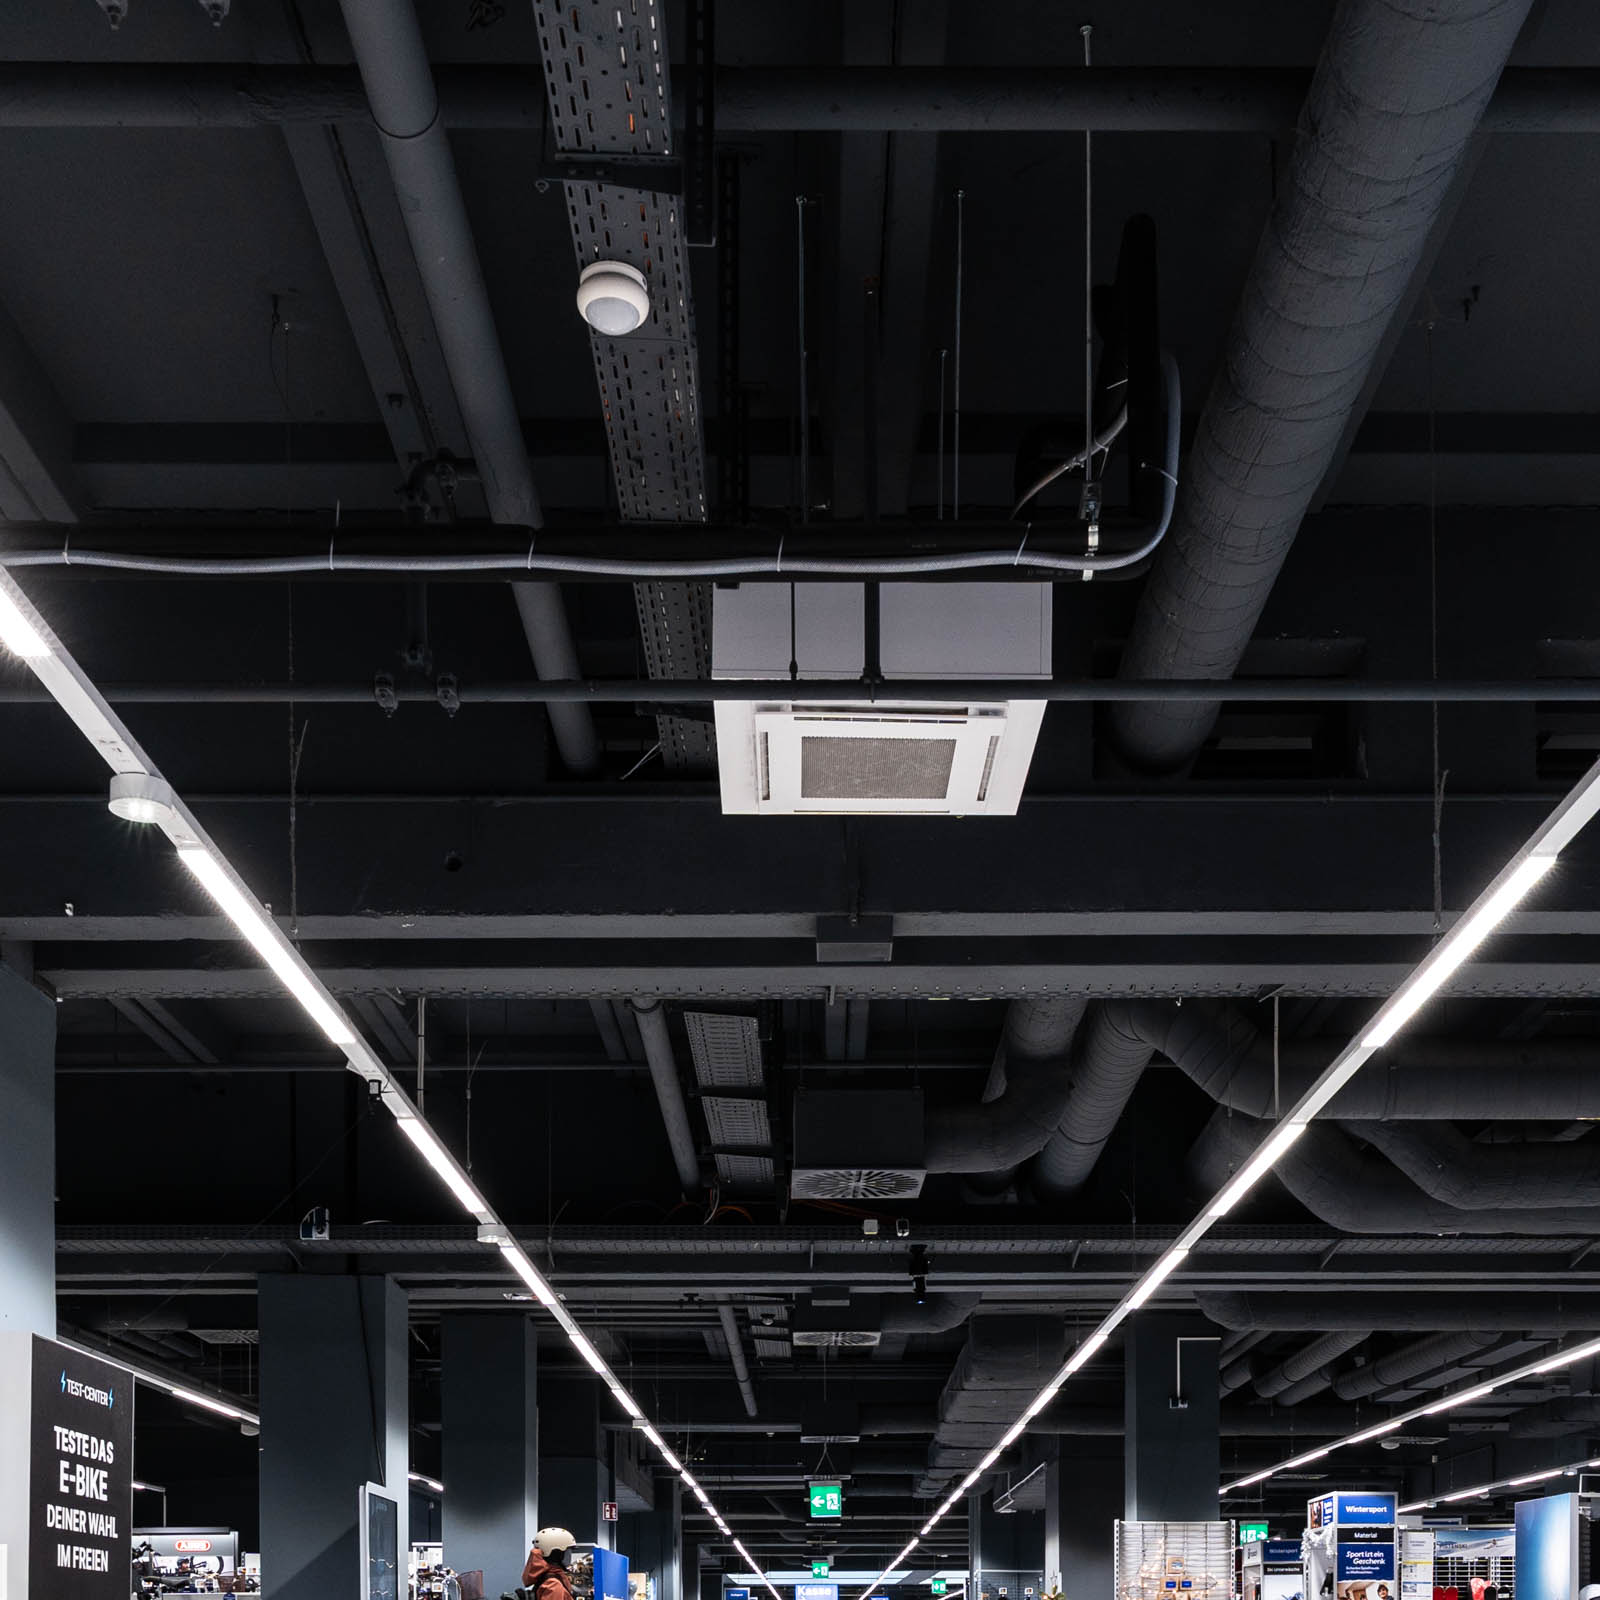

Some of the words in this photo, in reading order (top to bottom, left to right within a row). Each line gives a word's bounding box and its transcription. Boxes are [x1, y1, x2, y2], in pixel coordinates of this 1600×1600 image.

[66, 1378, 109, 1407] TEST-CENTER
[53, 1425, 90, 1458] TESTE
[90, 1436, 114, 1465] DAS
[60, 1460, 109, 1502] E-BIKE
[1345, 1505, 1388, 1514] Wintersport
[46, 1503, 87, 1534] DEINER
[87, 1512, 119, 1539] WAHL
[1353, 1531, 1378, 1539] Material
[57, 1543, 71, 1568] IM
[72, 1545, 109, 1573] FREIEN
[1345, 1550, 1365, 1558] Sport
[1352, 1557, 1386, 1565] Geschenk
[797, 1585, 832, 1596] Kasse
